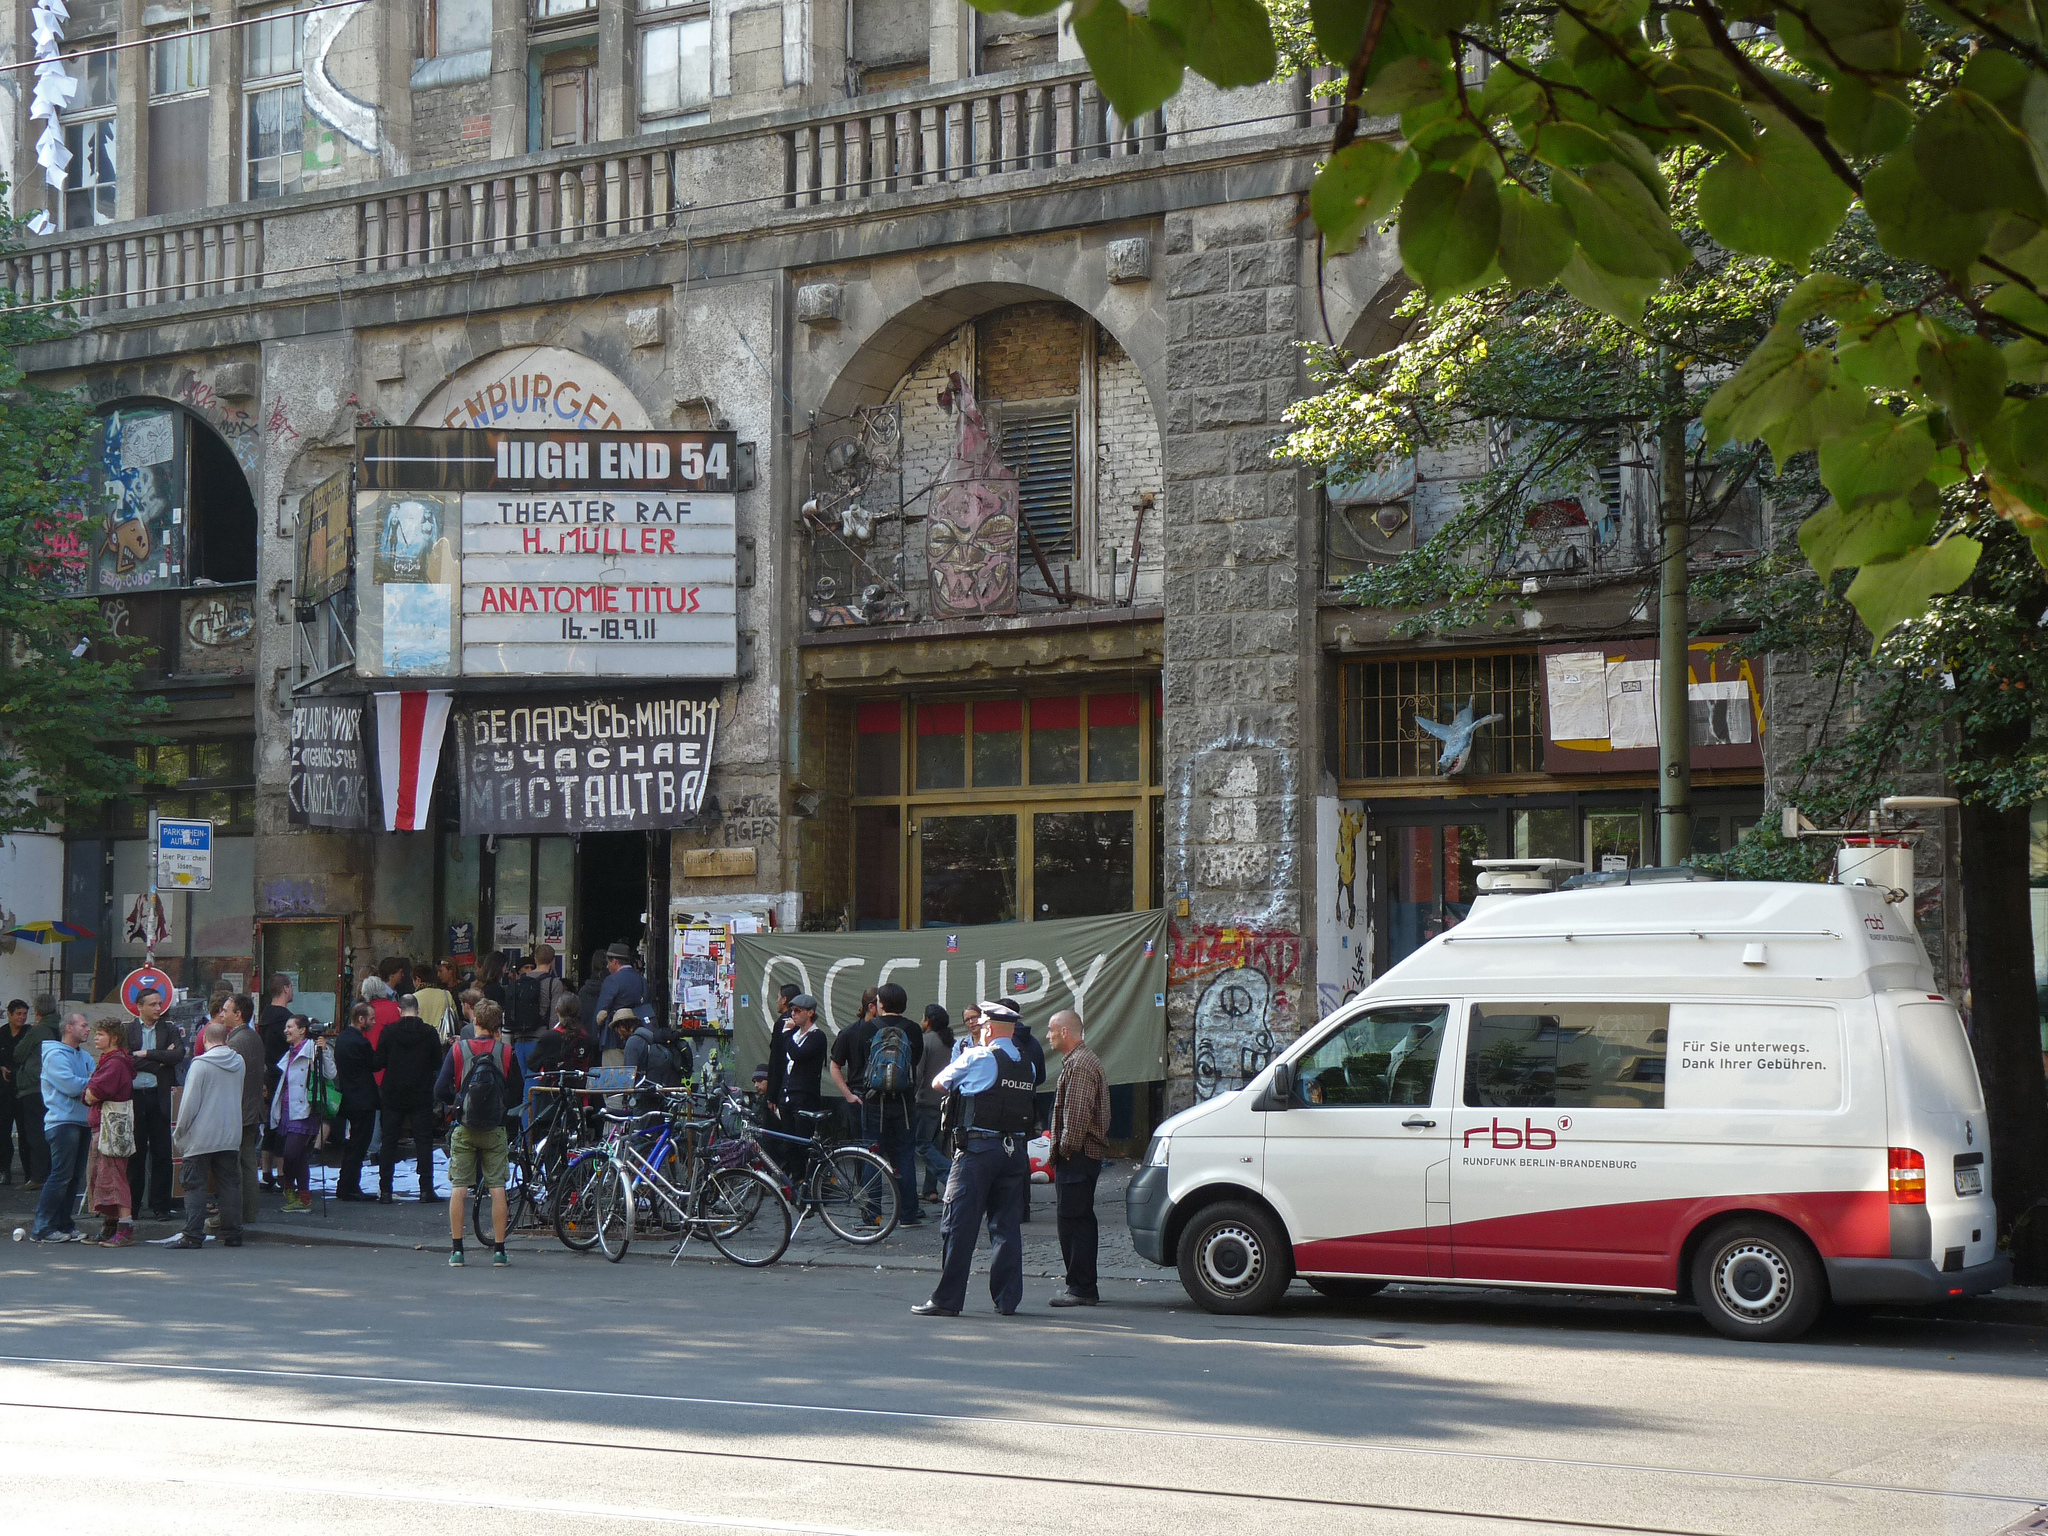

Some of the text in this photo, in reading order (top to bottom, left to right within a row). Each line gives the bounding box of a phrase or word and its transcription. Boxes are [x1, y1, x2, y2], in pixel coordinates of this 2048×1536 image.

[600, 442, 671, 480] END
[681, 442, 730, 480] 54
[498, 500, 691, 524] THEATER RAF
[522, 526, 676, 554] H. MÜLLER
[481, 586, 701, 613] ANATOMIE TITUS
[163, 827, 207, 837] PARKSHEIN-
[162, 852, 207, 862] Hier Parchein
[1682, 1040, 1810, 1054] Für Sie unterwegs.
[1682, 1058, 1827, 1070] Dank Ihrer Gebühren.
[1001, 1078, 1034, 1091] POLIZEI
[1463, 1116, 1557, 1150] rbb
[1462, 1157, 1638, 1169] RUNDFUNK BERLIN-BRANDENBURG
